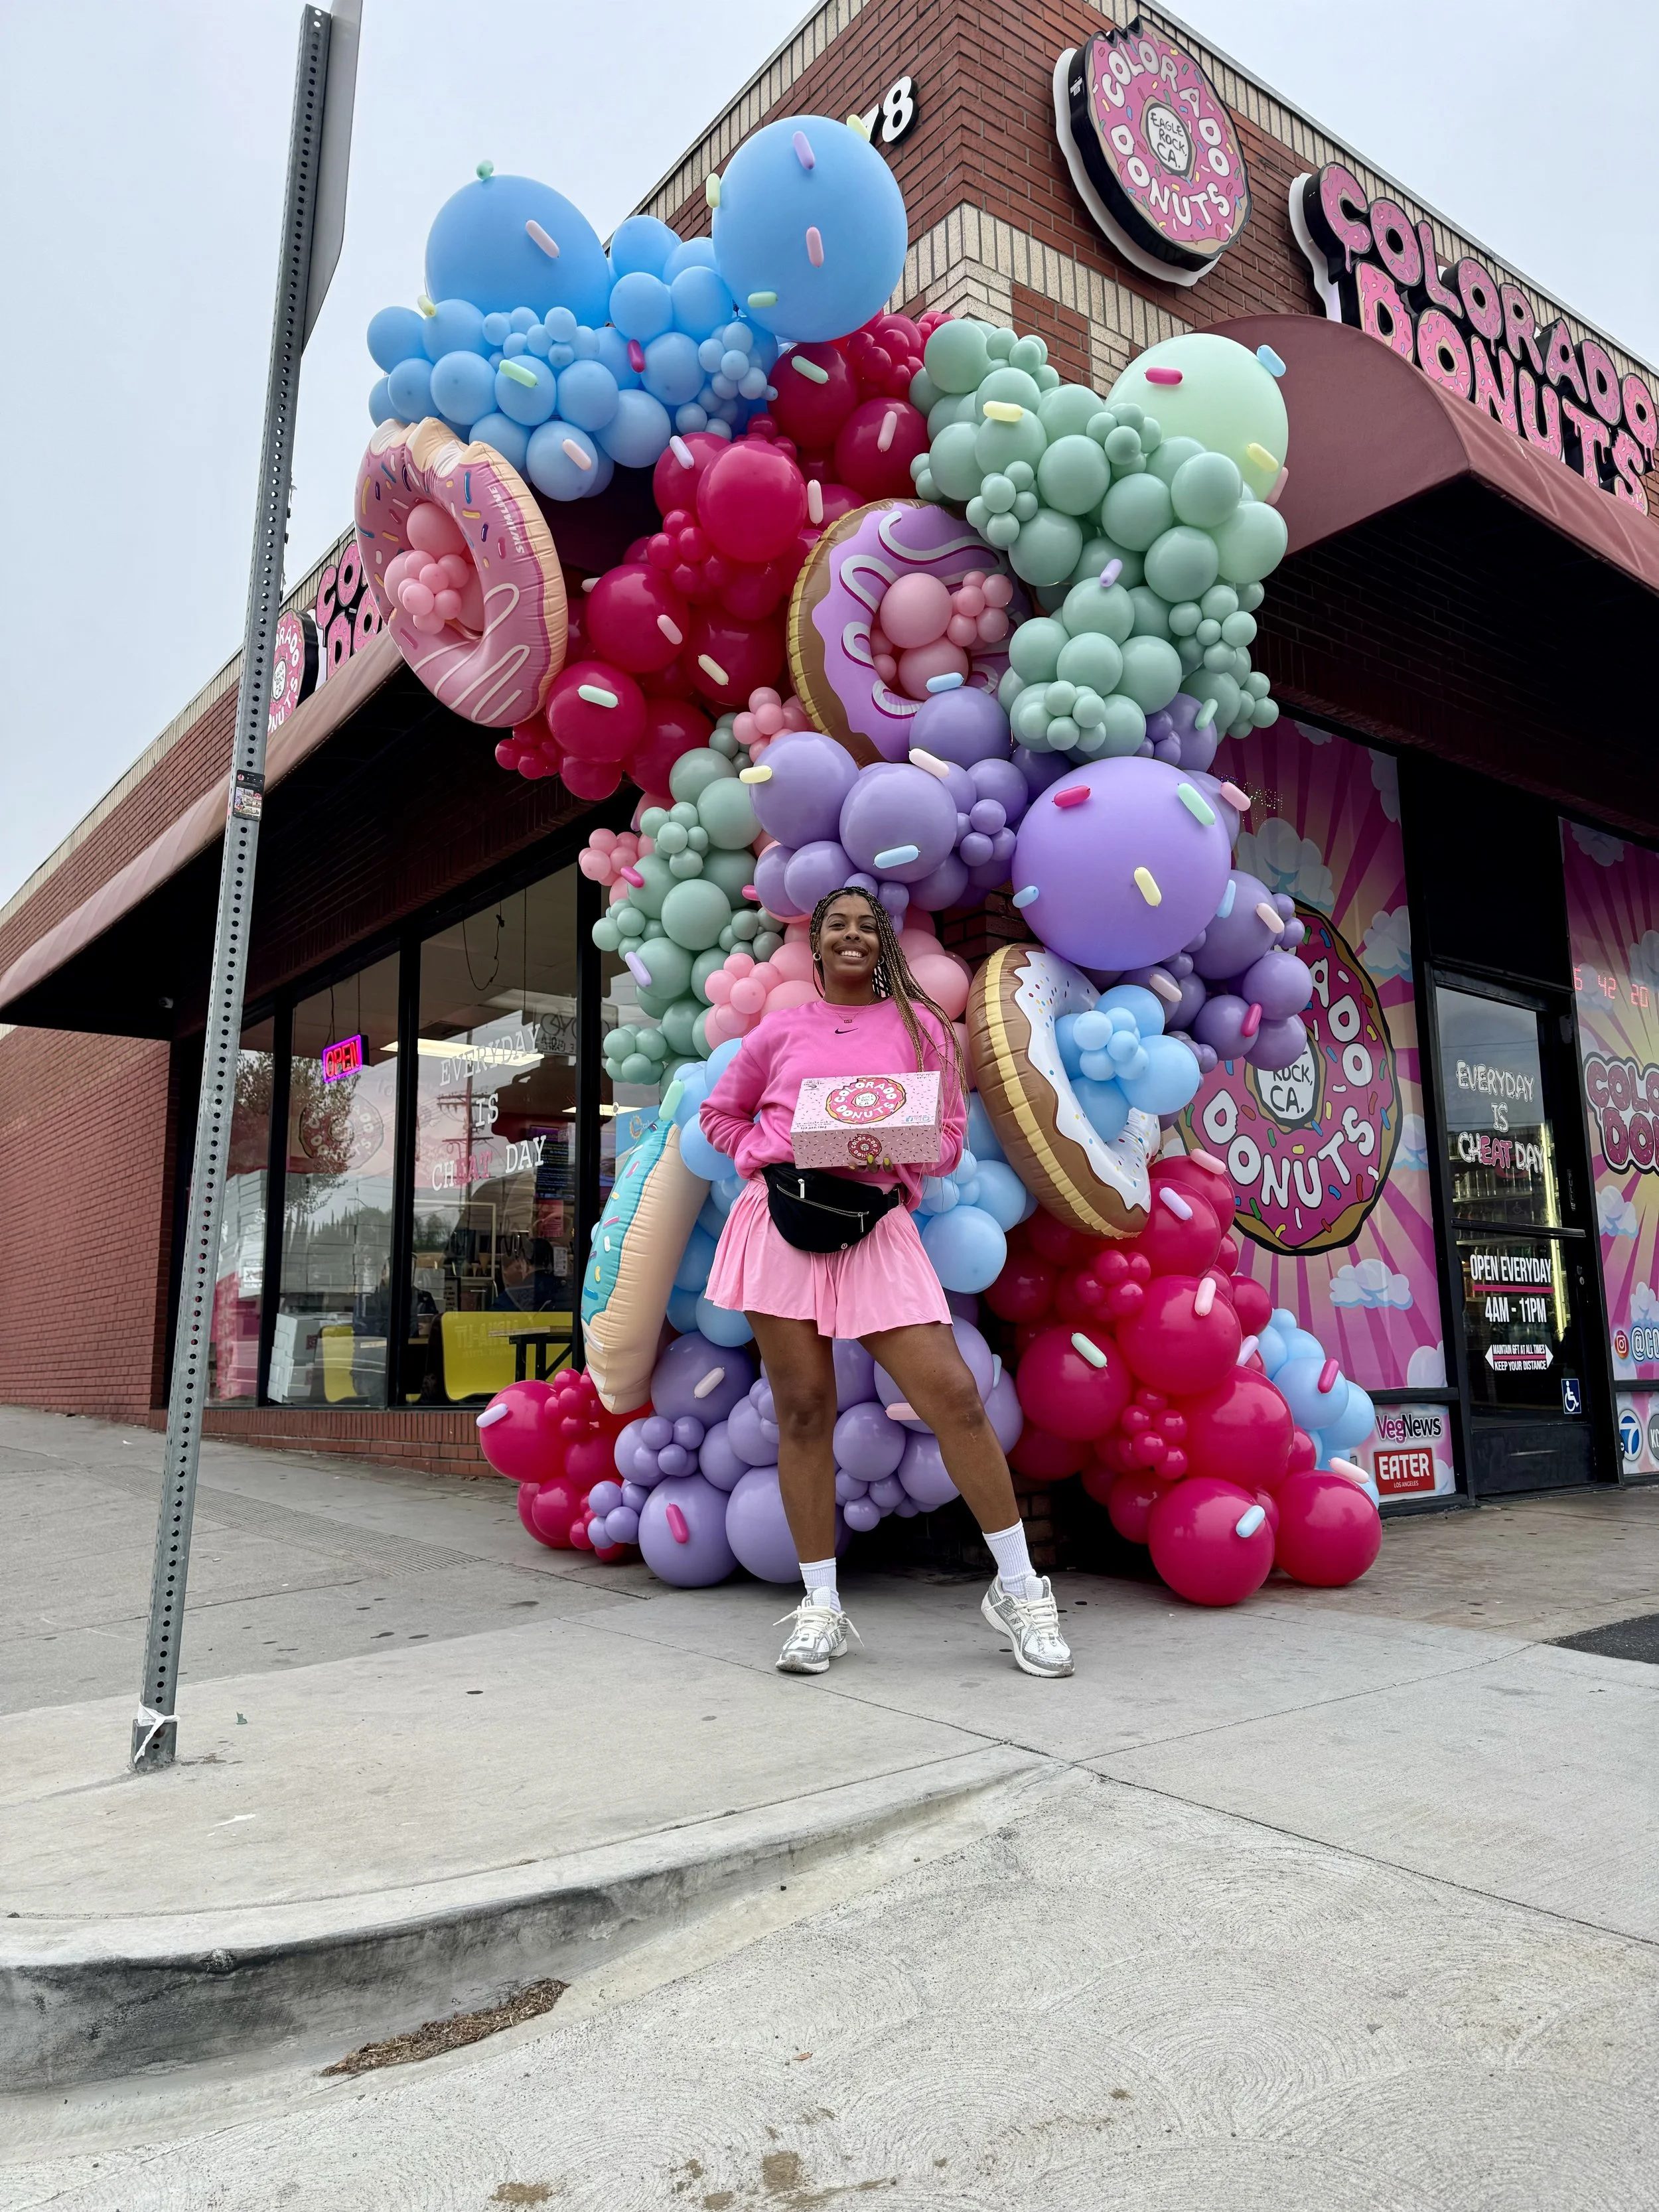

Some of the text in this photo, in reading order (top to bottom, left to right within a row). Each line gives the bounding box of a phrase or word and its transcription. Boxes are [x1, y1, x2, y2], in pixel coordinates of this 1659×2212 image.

[1102, 40, 1230, 177] COLORADO
[1150, 111, 1184, 137] EAGLE
[1157, 141, 1181, 168] CA.
[1110, 123, 1230, 226] DONUTS
[1319, 162, 1658, 469] COLORADO
[1355, 261, 1650, 517] DONUTS
[1597, 975, 1617, 999] 42
[1630, 983, 1650, 1008] 20
[325, 1039, 360, 1077] OPEN
[440, 1023, 541, 1086] EVERYDAY
[833, 1081, 897, 1103] COLORADO
[1456, 1059, 1535, 1102] EVERYDAY
[475, 1092, 499, 1127] IS
[835, 1102, 895, 1120] DONUTS
[1269, 1085, 1306, 1114] CA.
[1490, 1102, 1509, 1133] IS
[432, 1150, 492, 1191] CHEAT
[505, 1135, 547, 1173] DAY
[1202, 1089, 1376, 1210] DONUTS
[1457, 1131, 1545, 1173] CHEAT DAY
[1470, 1254, 1551, 1283] OPEN EVERYDAY
[1484, 1296, 1510, 1322] 4AM
[1519, 1297, 1548, 1323] 11PM
[1493, 1344, 1512, 1355] MAINTAIN
[1520, 1345, 1526, 1355] AT
[1534, 1344, 1545, 1354] TIMES
[1494, 1360, 1547, 1371] KEEP YOUR DISTANCE
[1375, 1414, 1441, 1444] VegNews
[1378, 1453, 1430, 1481] EATER
